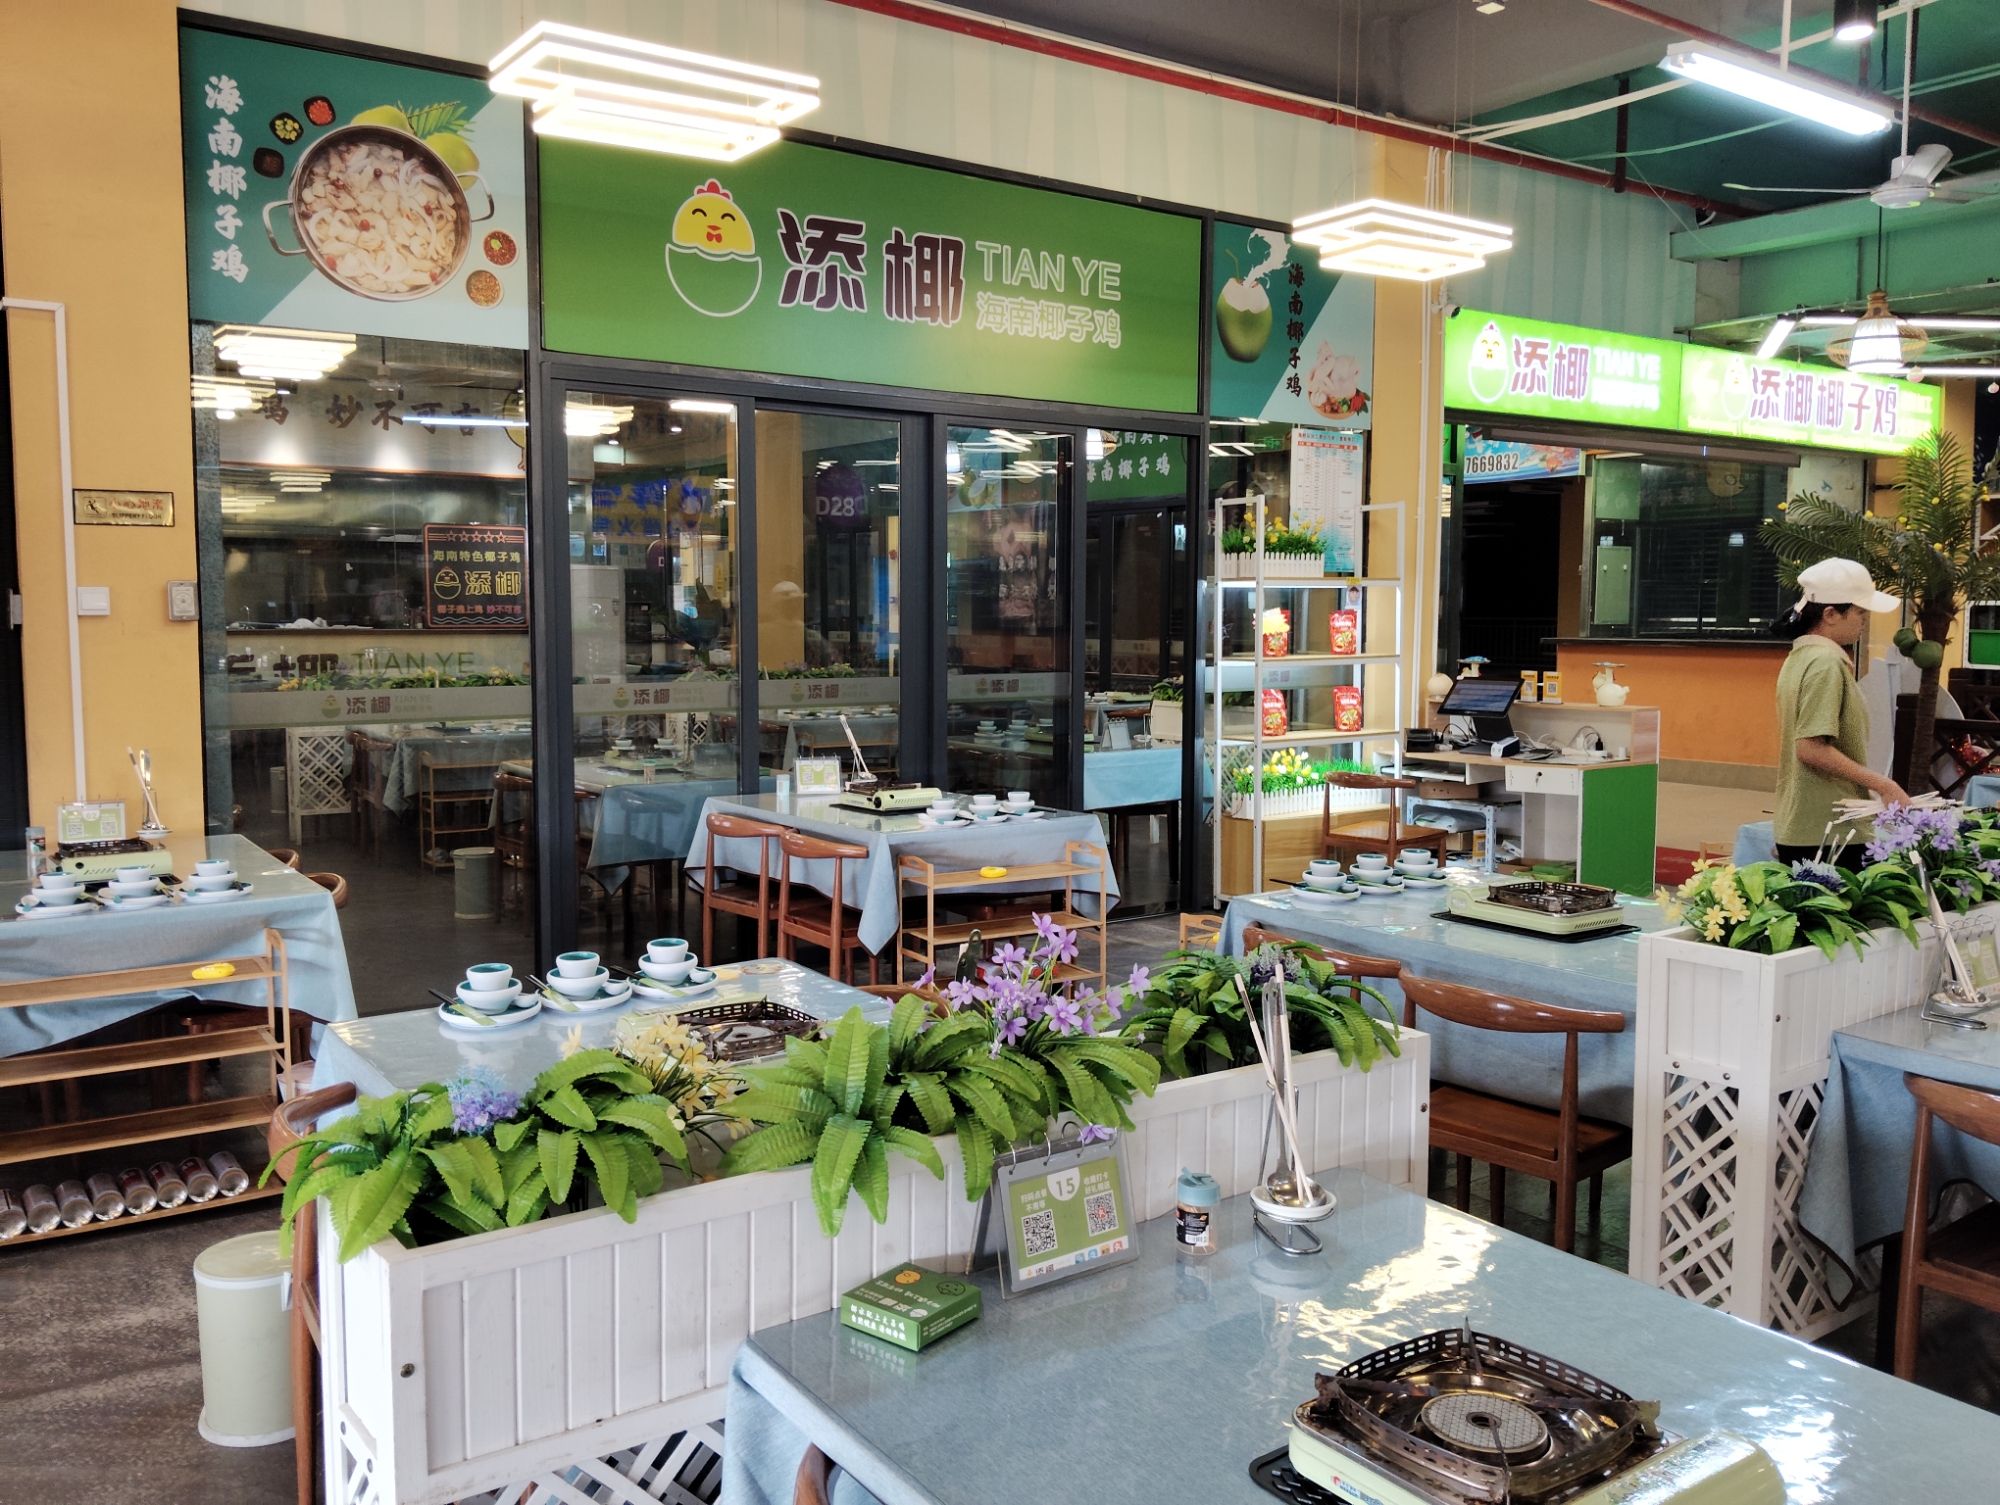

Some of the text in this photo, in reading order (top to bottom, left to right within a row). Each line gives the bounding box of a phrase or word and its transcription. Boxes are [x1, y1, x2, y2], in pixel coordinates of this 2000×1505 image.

[204, 75, 249, 284] 海南椰子鸡
[777, 208, 965, 327] 添椰
[976, 240, 1122, 300] TIAN YE
[975, 291, 1122, 349] 海南椰子鸡
[1285, 263, 1304, 397] 海南椰子鸡
[1511, 337, 1590, 400] 添椰
[1749, 367, 1898, 437] 添椰椰子鸡
[433, 550, 521, 563] 海南特色椰子鸡
[464, 570, 522, 596] 添椰
[435, 651, 475, 674] YE
[346, 696, 391, 715] 添椰
[634, 687, 671, 705] 添椰
[1056, 1177, 1076, 1197] 15
